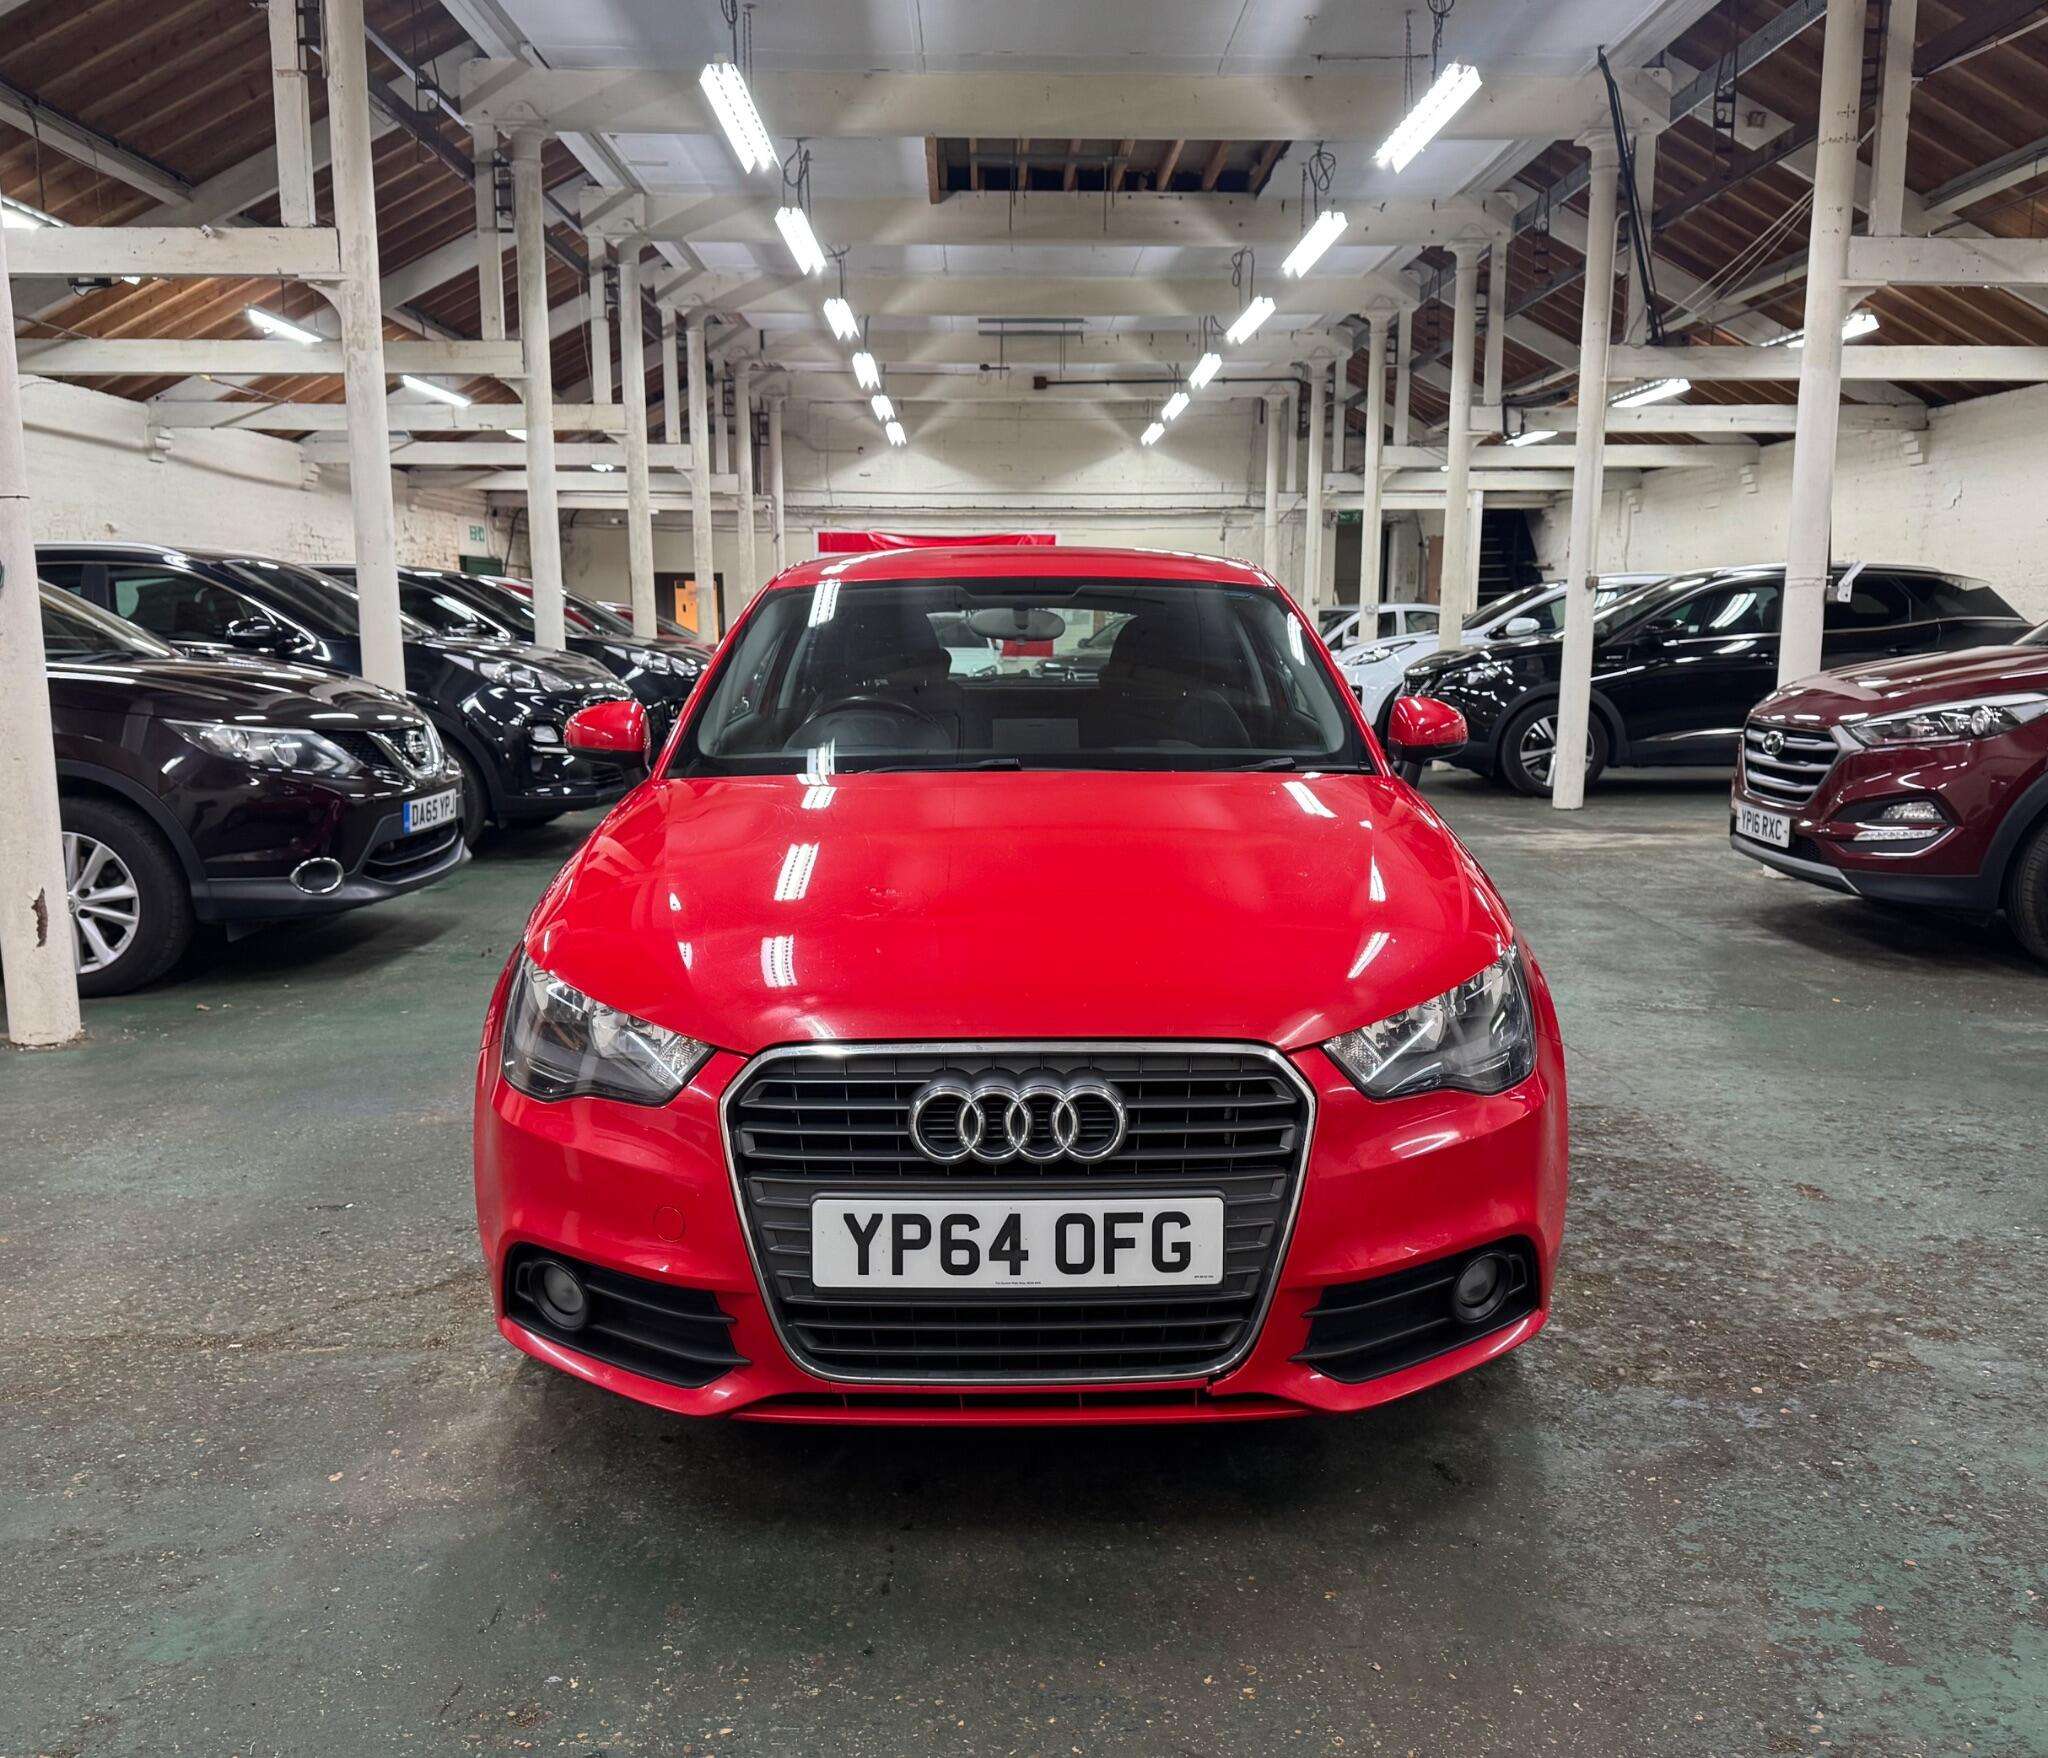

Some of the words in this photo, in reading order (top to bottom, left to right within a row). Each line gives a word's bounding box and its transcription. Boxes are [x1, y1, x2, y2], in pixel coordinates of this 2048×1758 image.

[412, 799, 438, 826] DA65
[440, 792, 455, 818] YPJ
[1742, 808, 1760, 834] YP16
[1762, 815, 1782, 840] RXC
[843, 1212, 1029, 1276] YP64
[1054, 1211, 1192, 1275] OFG
